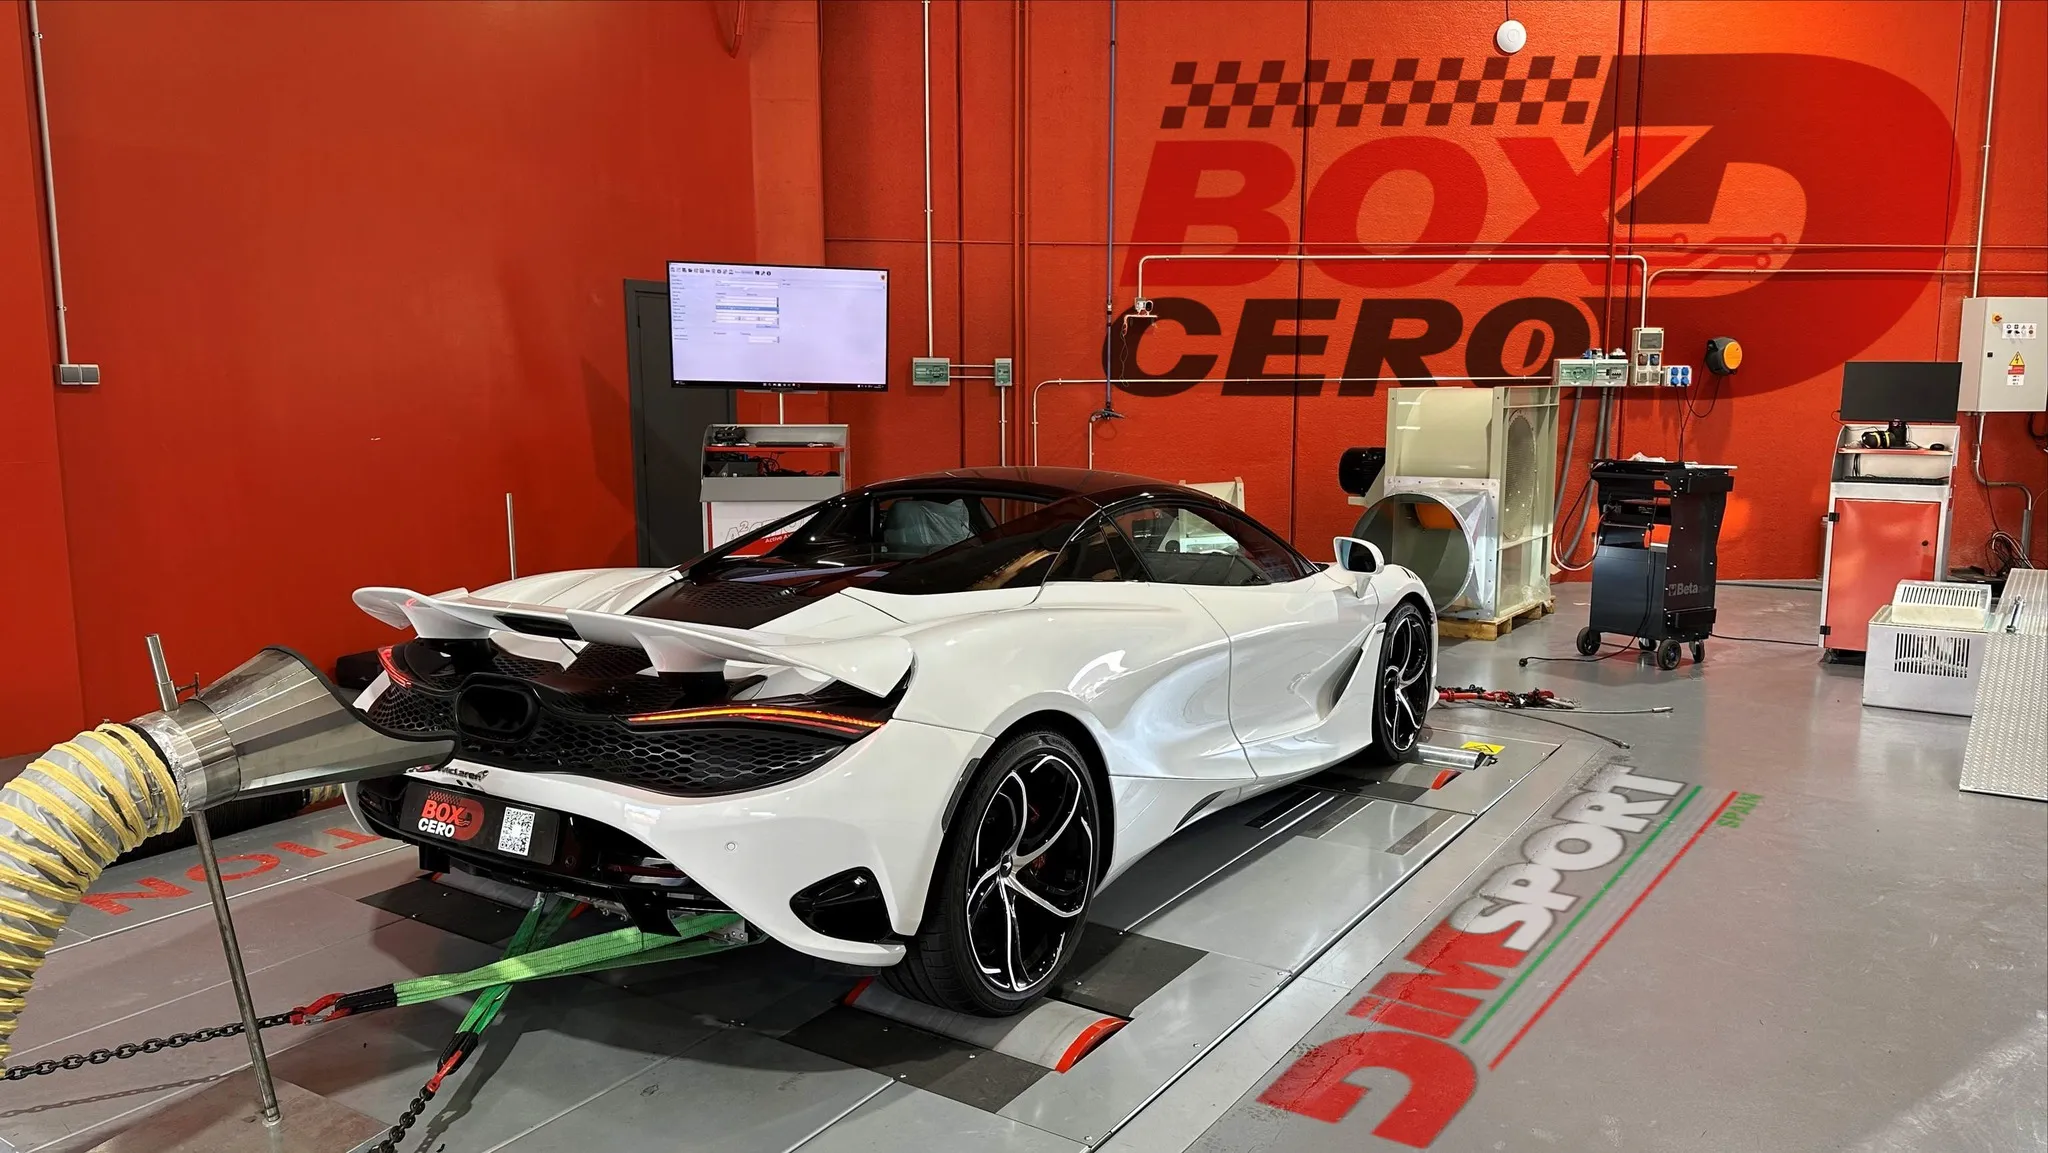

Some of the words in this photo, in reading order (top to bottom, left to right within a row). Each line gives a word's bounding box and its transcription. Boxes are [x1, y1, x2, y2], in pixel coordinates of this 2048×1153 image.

[1120, 136, 1688, 288] BOX
[1102, 298, 1591, 397] CERO
[1678, 582, 1699, 595] Beta
[422, 800, 464, 826] BOX
[1716, 792, 1763, 828] SPAIN
[418, 818, 456, 838] CERO
